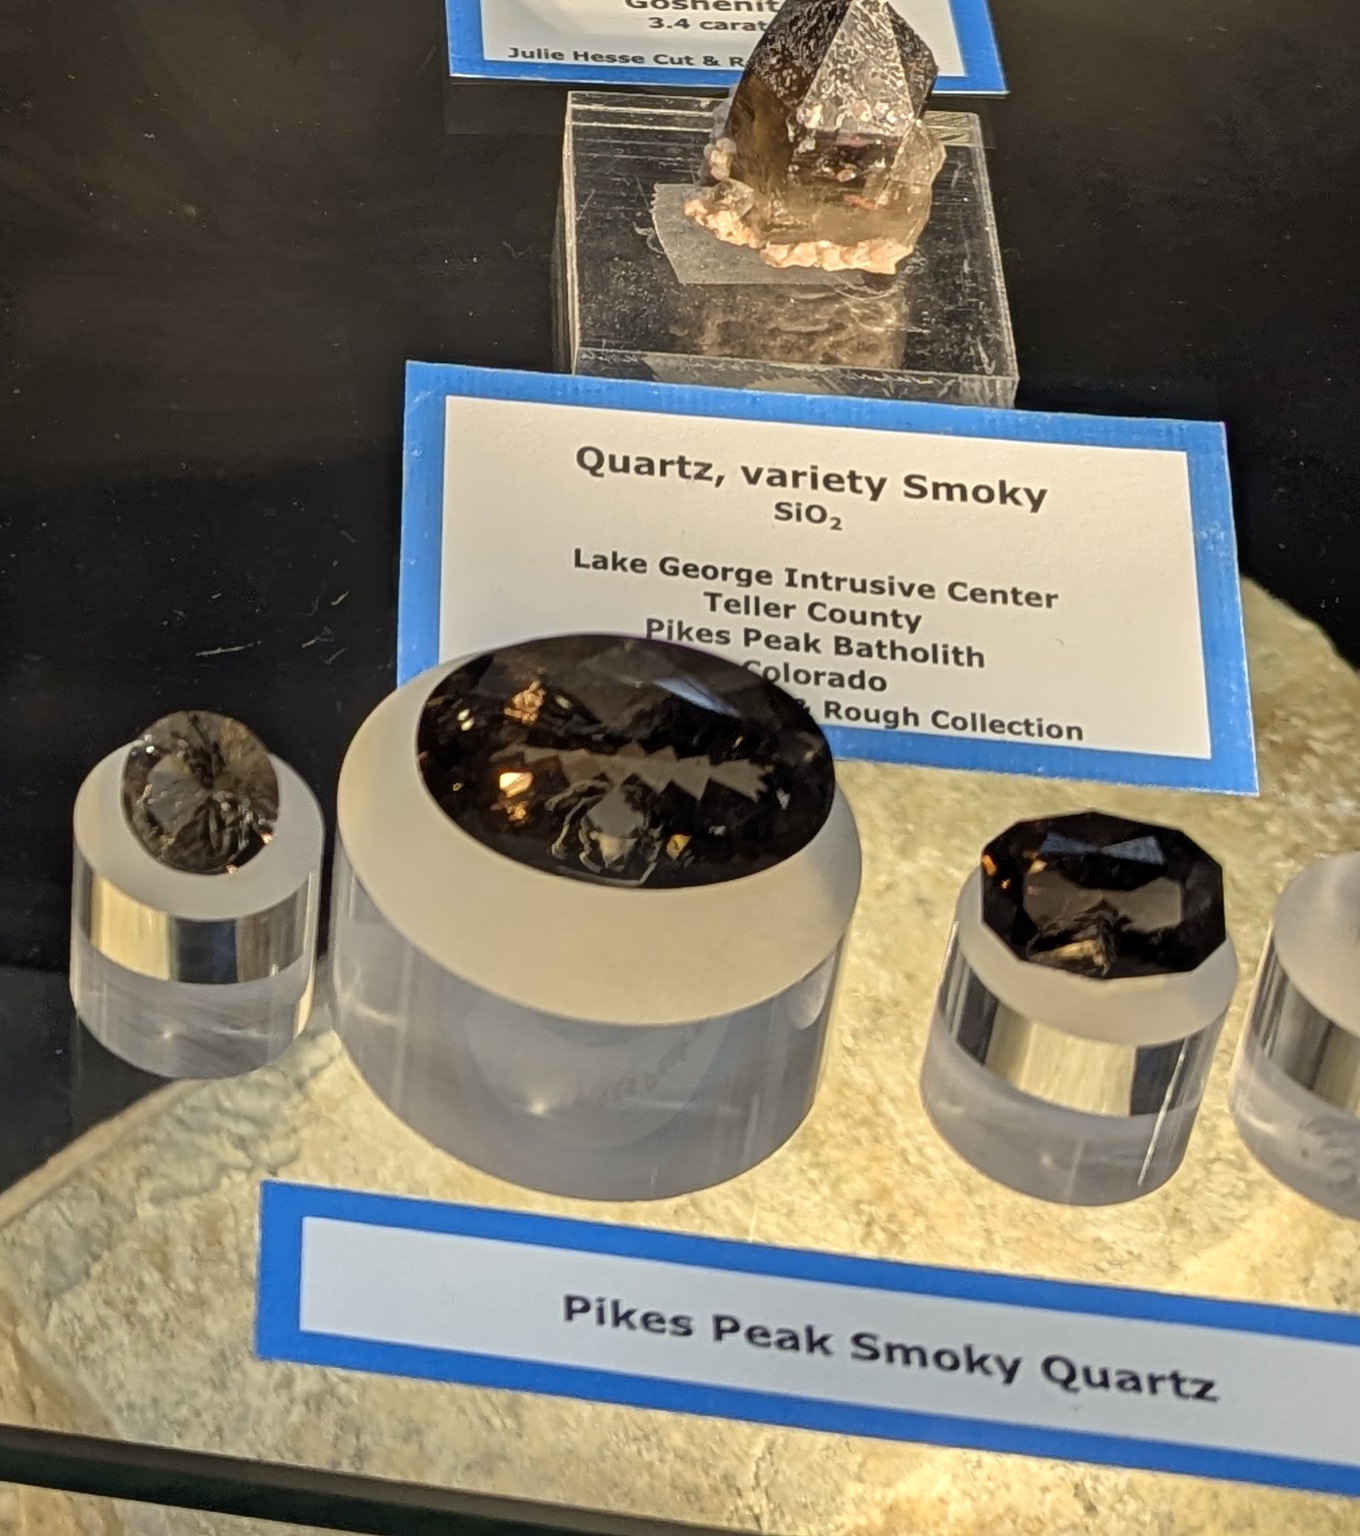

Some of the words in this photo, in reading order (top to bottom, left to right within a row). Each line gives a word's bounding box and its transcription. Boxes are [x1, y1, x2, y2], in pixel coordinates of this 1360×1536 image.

[648, 17, 690, 29] 3.4
[699, 19, 767, 32] carat
[508, 47, 564, 61] Julie
[573, 49, 644, 63] Hesse
[653, 52, 694, 65] Cut
[702, 54, 720, 66] &
[575, 445, 727, 489] Quartz,
[739, 457, 889, 502] variety
[902, 471, 1049, 514] Smoky
[572, 547, 648, 579] Lake
[658, 556, 774, 590] George
[783, 567, 937, 600] Intrusive
[947, 580, 1059, 611] Center
[704, 592, 797, 620] Teller
[807, 601, 923, 634] County
[644, 617, 732, 647] Pikes
[741, 626, 823, 656] Peak
[832, 636, 987, 669] Batholith
[822, 698, 921, 730] Rough
[930, 710, 1084, 742] Collection
[561, 1294, 694, 1337] Pikes
[711, 1313, 833, 1357] Peak
[850, 1332, 1021, 1385] Smoky
[1040, 1356, 1219, 1404] Quartz
